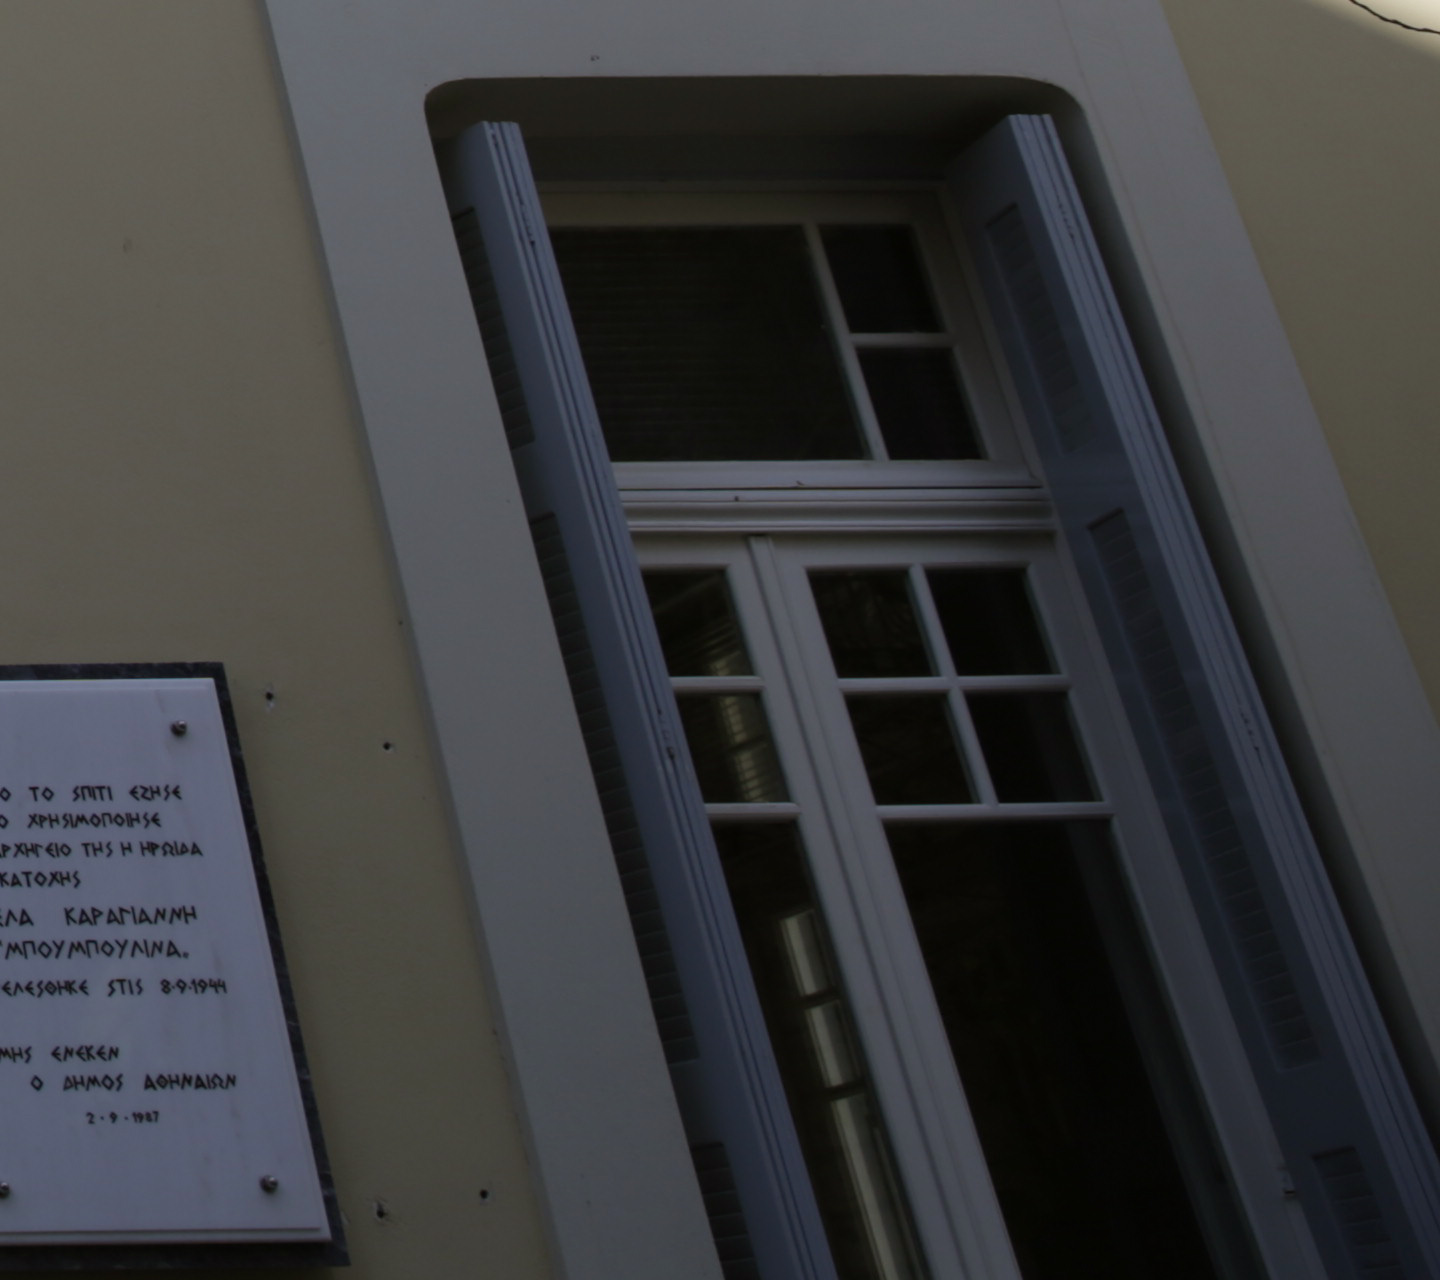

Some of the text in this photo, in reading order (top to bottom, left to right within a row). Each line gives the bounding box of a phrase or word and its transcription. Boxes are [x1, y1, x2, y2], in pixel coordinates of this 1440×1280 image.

[28, 786, 55, 802] ΤΟ
[120, 842, 133, 857] Η
[139, 840, 203, 857] ΗΡΩΙΔΑ
[64, 905, 197, 926] ΚΑΡΑΓΙΑΝΝΗ
[50, 1045, 119, 1062] ΕΝΕΚΕΝ
[30, 1075, 44, 1092] Ο
[144, 1073, 237, 1091] ΑΘΗΝΑΙΩΝ
